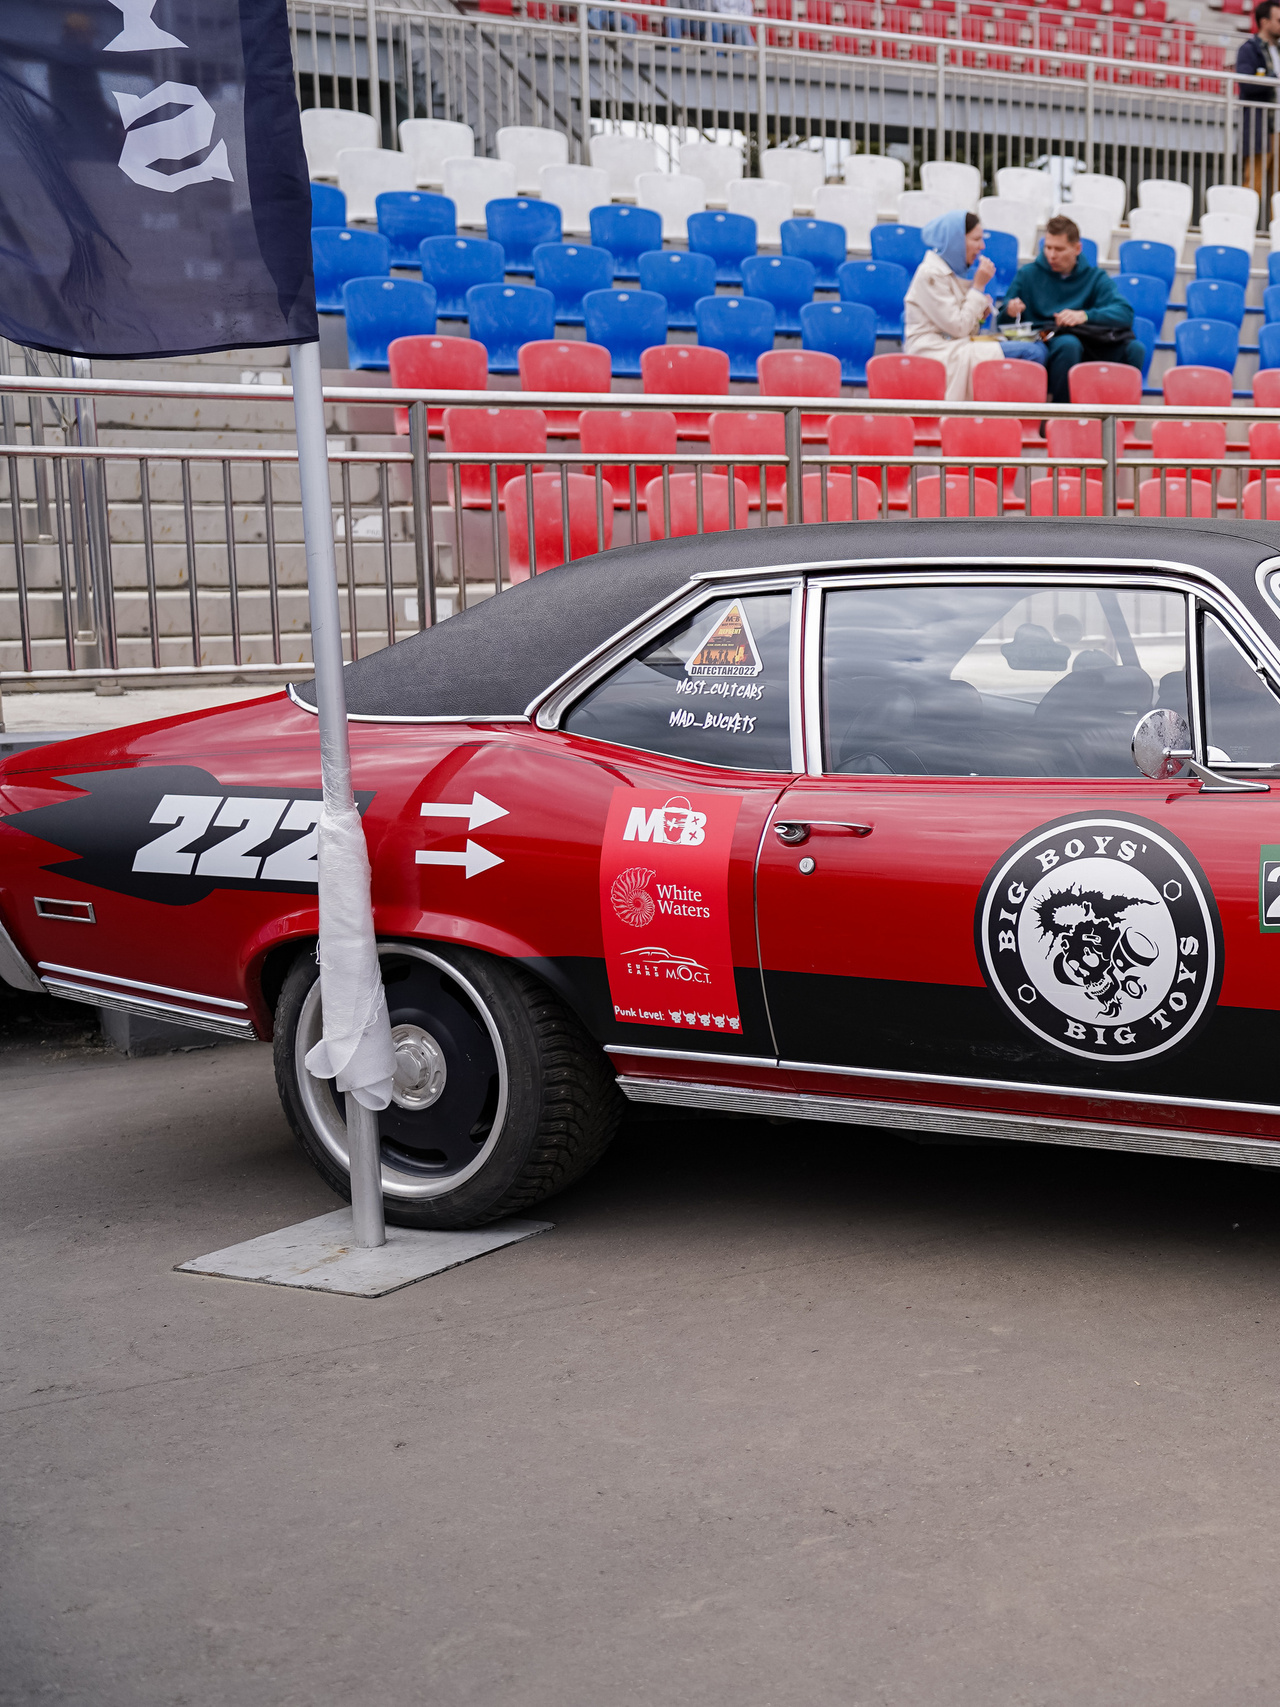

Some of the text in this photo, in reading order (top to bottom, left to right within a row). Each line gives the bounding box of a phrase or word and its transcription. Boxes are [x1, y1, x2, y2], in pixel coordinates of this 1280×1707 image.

[669, 708, 757, 734] MAD_BUCKETS
[131, 794, 359, 883] 222
[656, 884, 703, 902] White
[657, 899, 711, 919] Waters
[998, 880, 1029, 954] BIG
[1063, 934, 1200, 1046] BIG TOYS
[614, 1005, 666, 1021] Punk Level:
